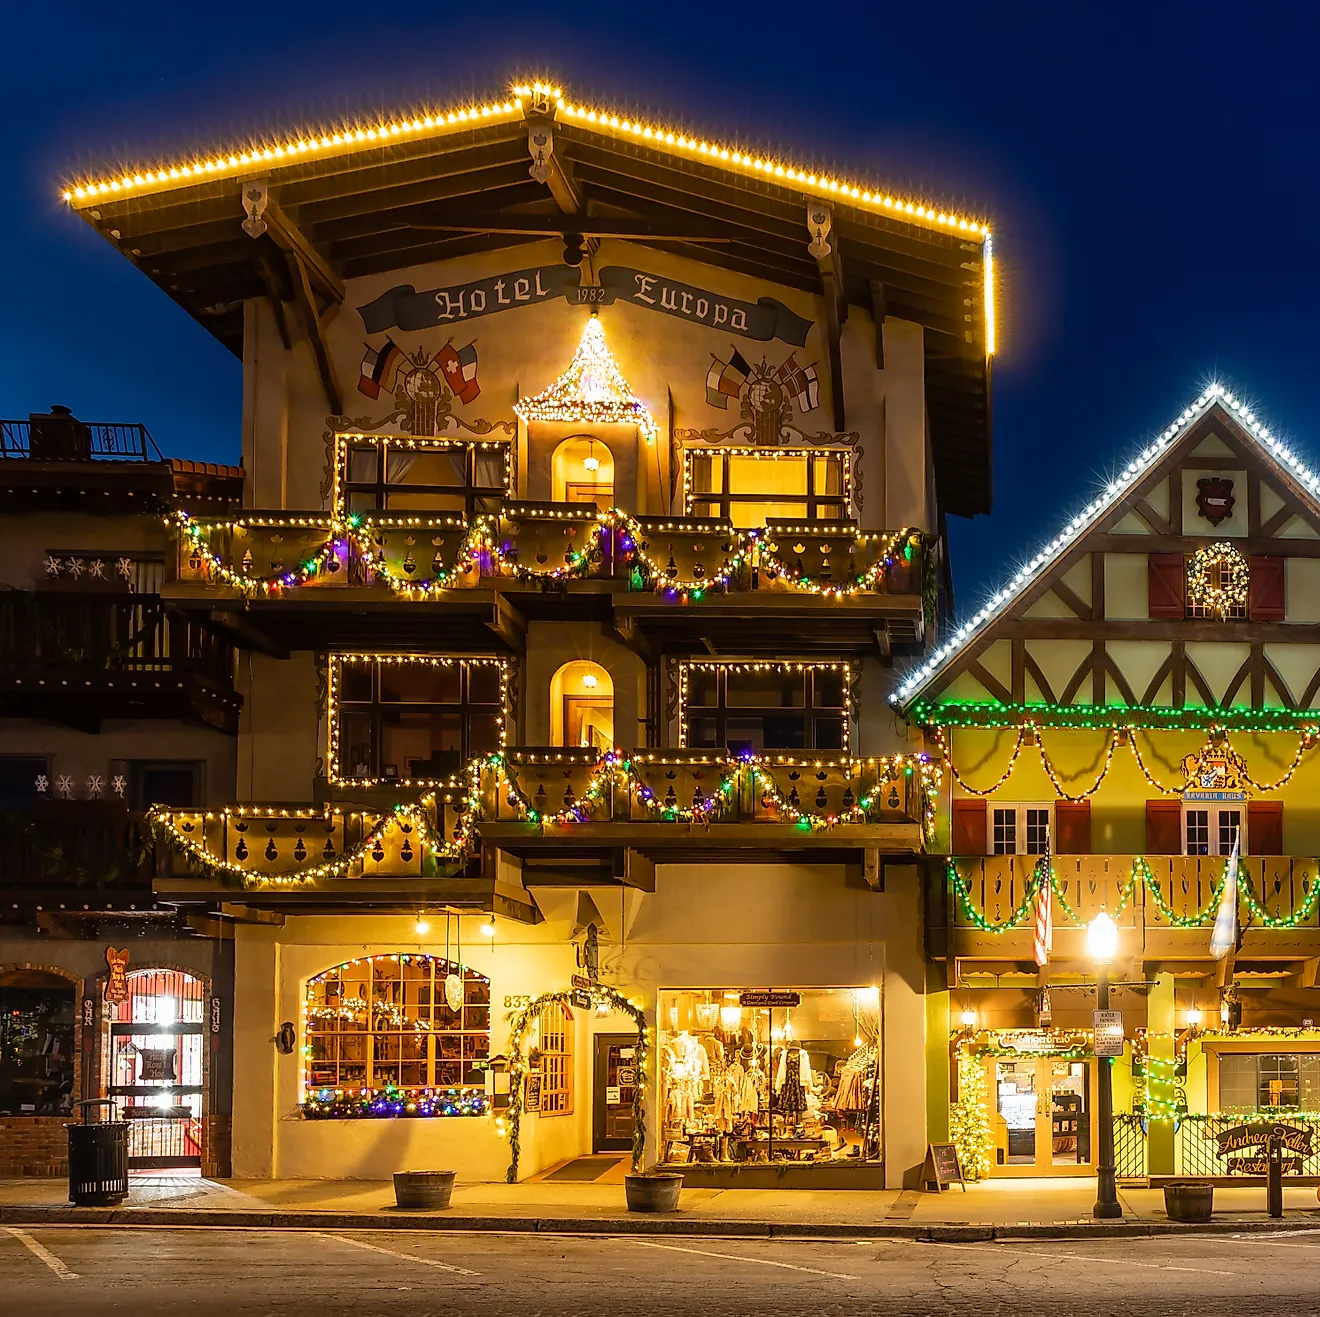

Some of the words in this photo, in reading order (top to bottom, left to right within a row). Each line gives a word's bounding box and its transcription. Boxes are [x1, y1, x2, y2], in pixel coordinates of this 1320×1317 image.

[435, 270, 551, 320] Hotel
[633, 274, 749, 331] Europa
[577, 288, 605, 302] 1982
[503, 995, 531, 1009] 833
[1273, 1127, 1310, 1153] Keller
[1228, 1157, 1295, 1173] Restant
